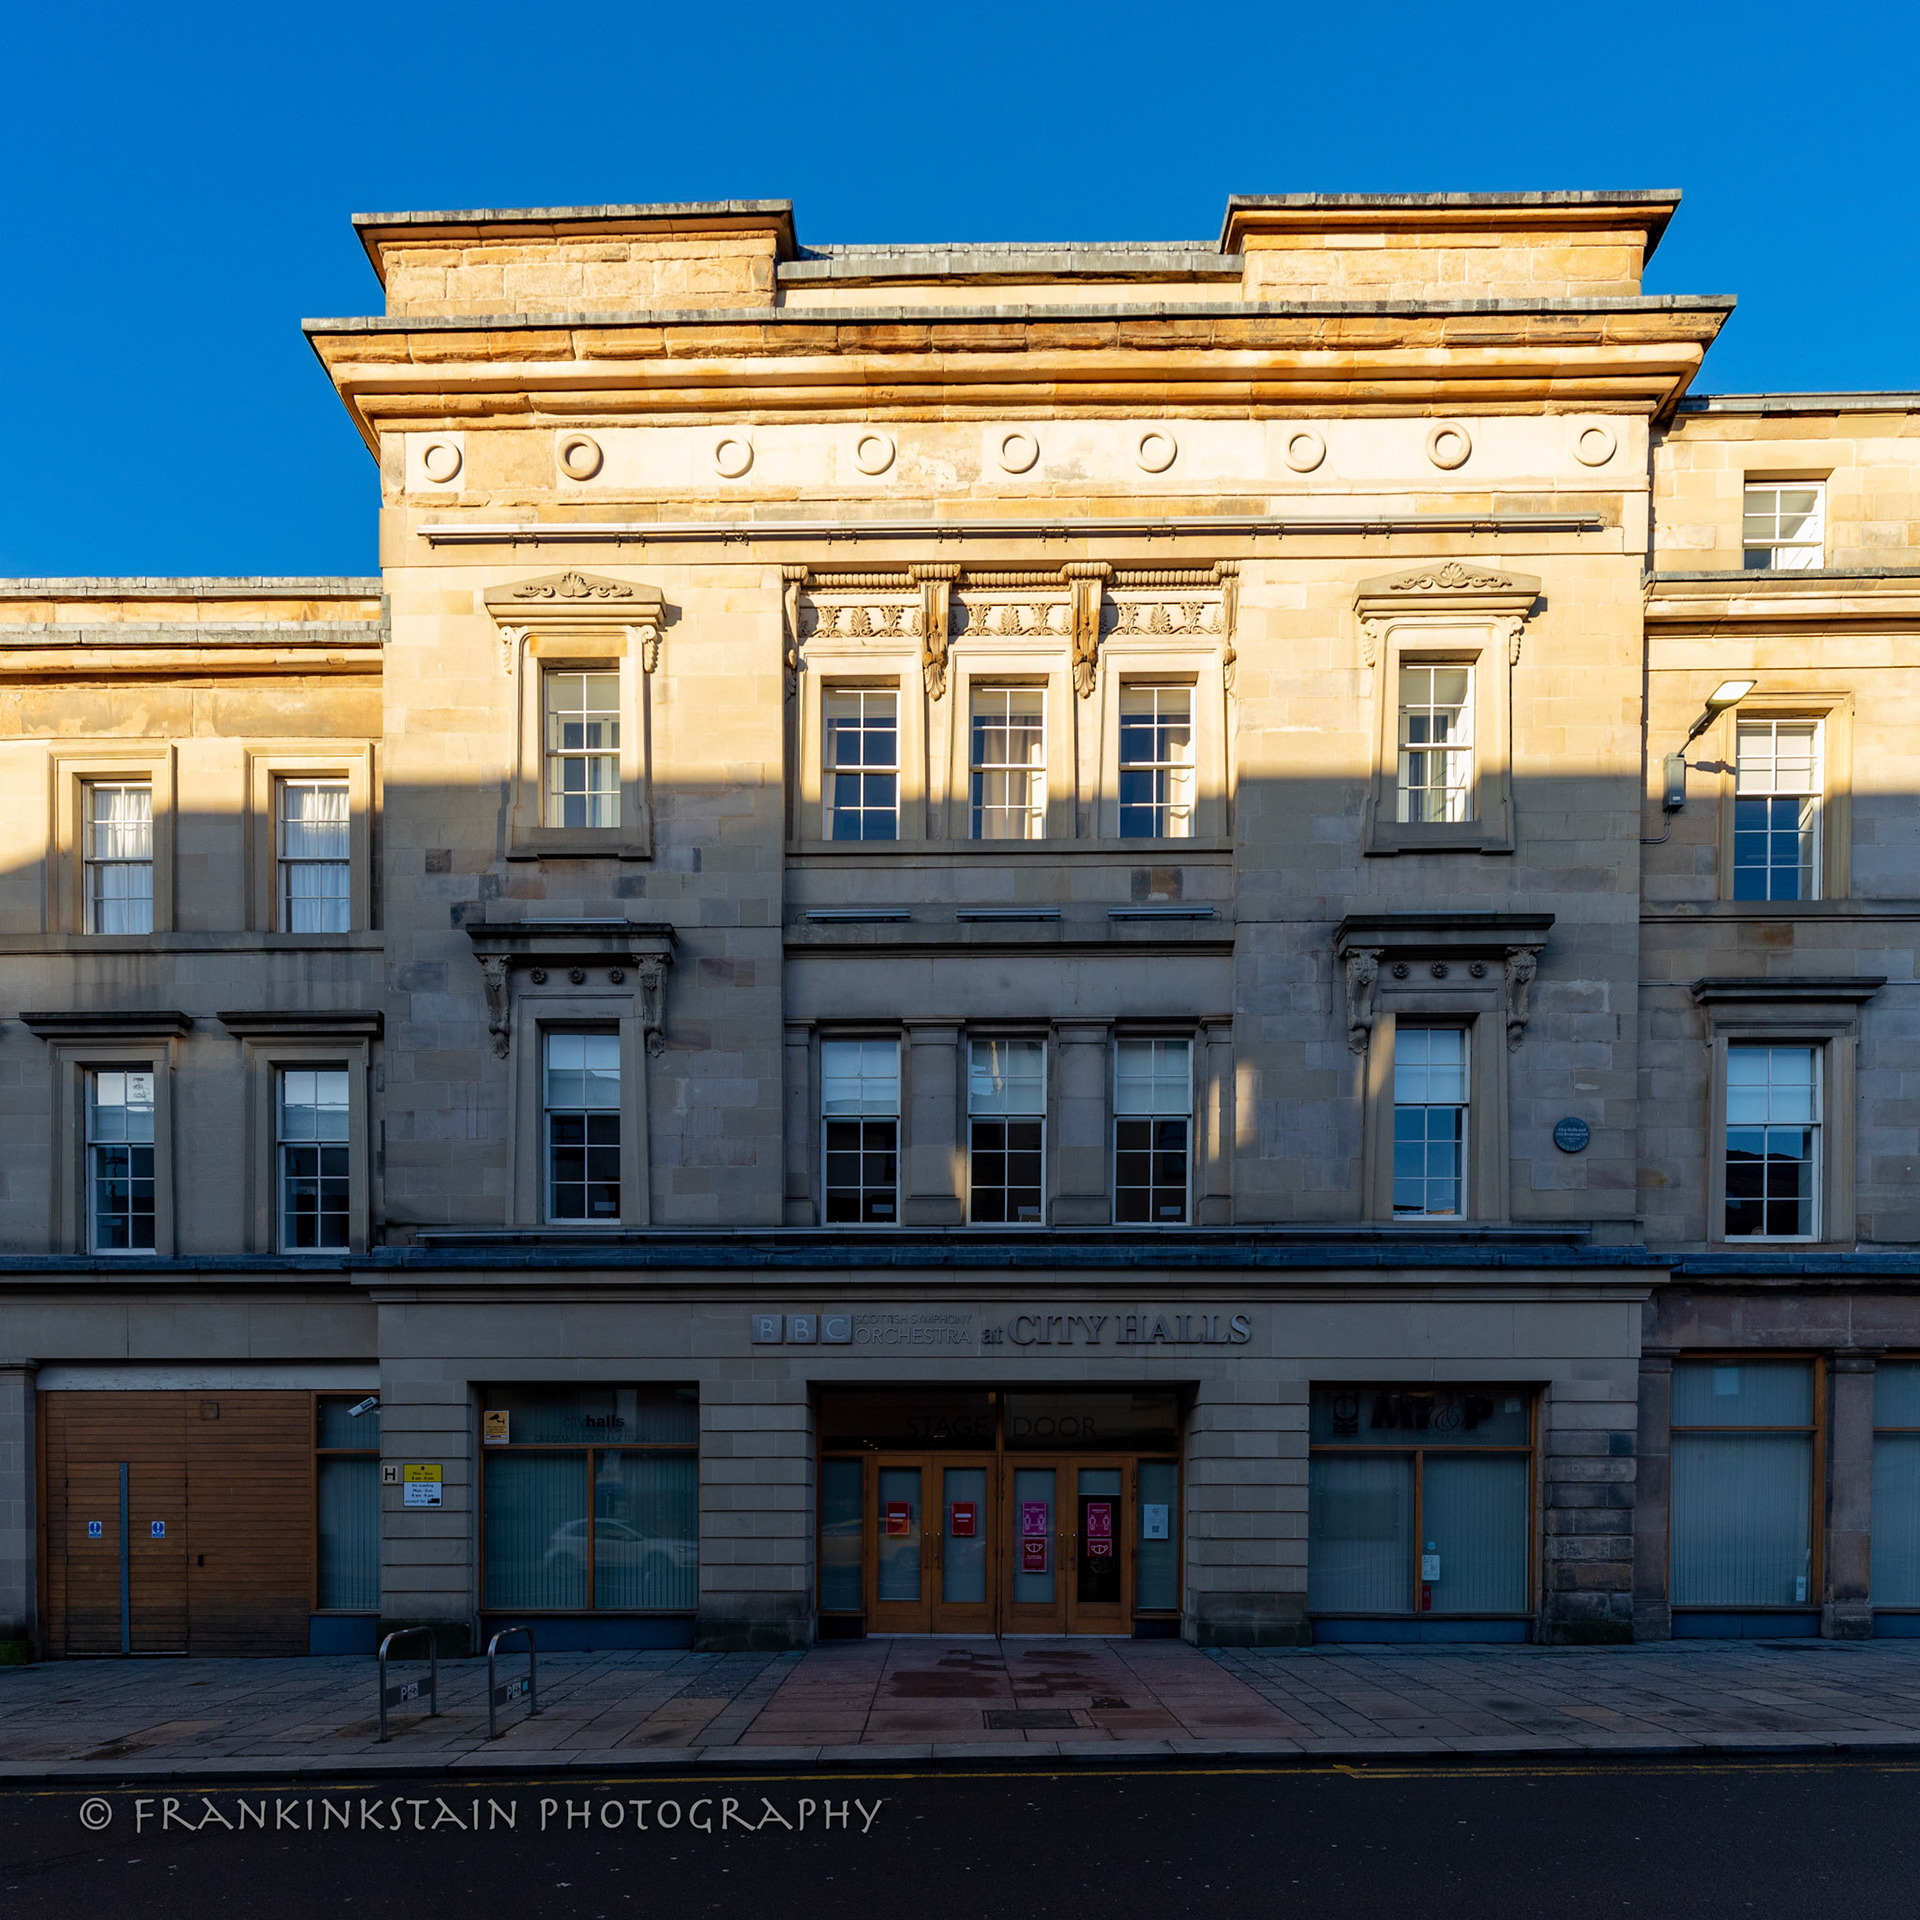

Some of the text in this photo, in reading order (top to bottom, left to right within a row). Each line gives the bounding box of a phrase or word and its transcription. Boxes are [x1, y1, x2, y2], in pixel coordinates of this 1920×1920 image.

[755, 1316, 850, 1342] BBC
[855, 1315, 973, 1325] SCOTTISH SYMPHONY
[982, 1313, 1251, 1344] at CITY HALLS
[854, 1327, 972, 1344] ORCHESTRA
[905, 1415, 1096, 1437] STAGE DOOR
[384, 1467, 396, 1481] H
